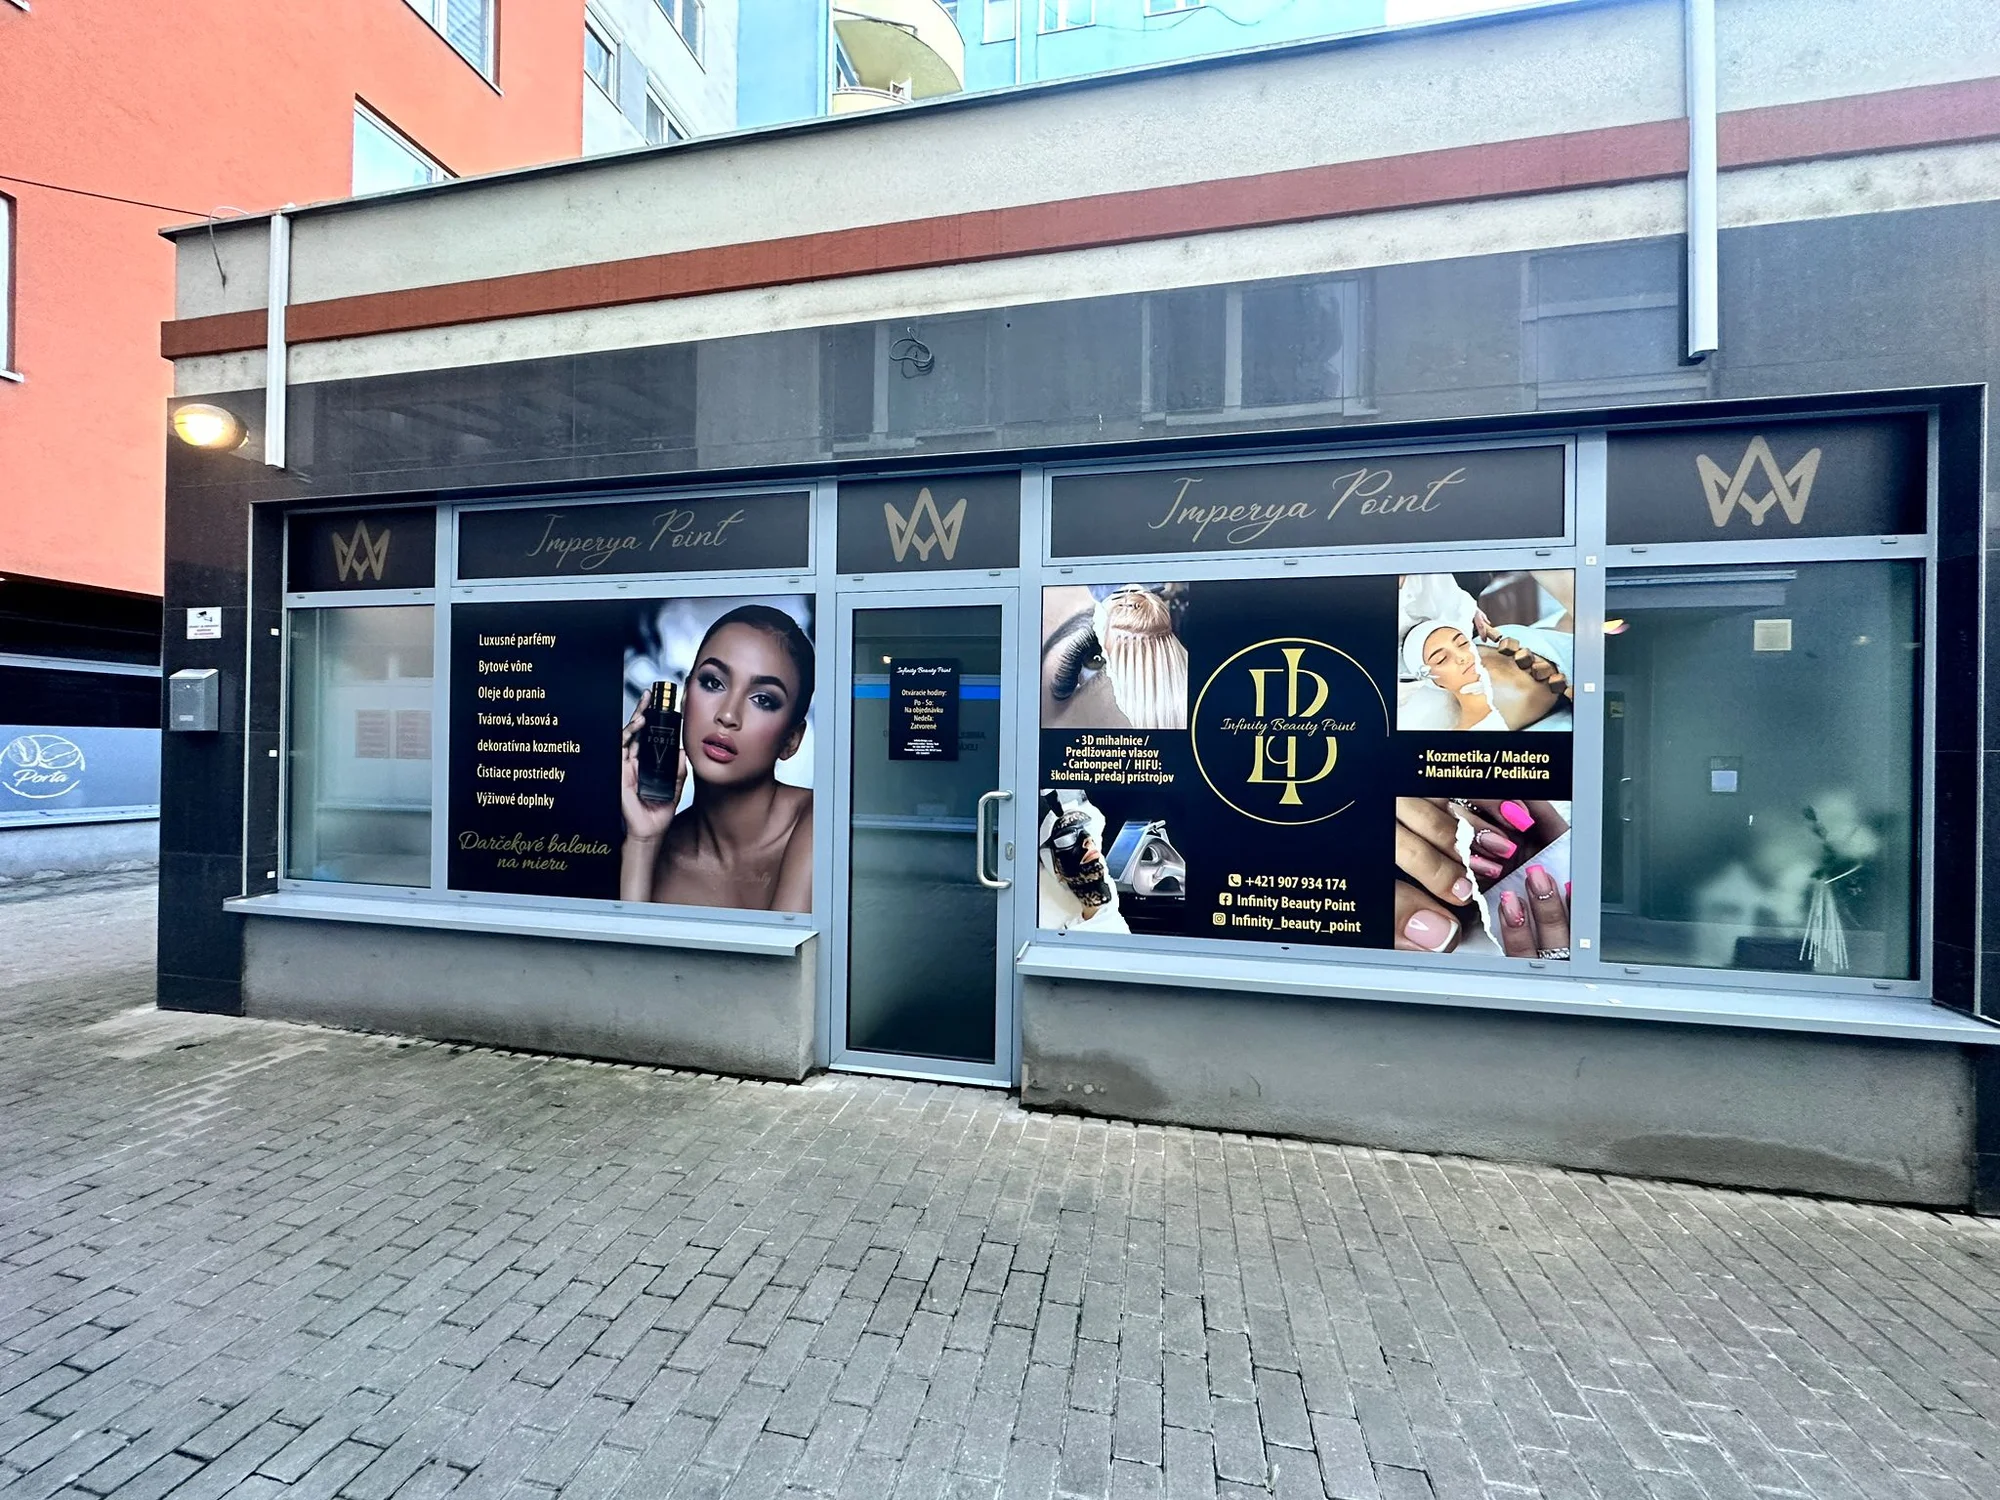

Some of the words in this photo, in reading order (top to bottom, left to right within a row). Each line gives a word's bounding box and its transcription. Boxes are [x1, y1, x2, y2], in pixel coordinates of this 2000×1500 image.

[1148, 477, 1317, 544] Imperya
[1327, 467, 1467, 521] Point
[526, 512, 642, 570] Imperya
[649, 508, 744, 551] Point
[479, 633, 516, 646] Luxusné
[517, 632, 556, 648] parfémy
[478, 660, 509, 675] Bytové
[510, 660, 533, 672] vône
[477, 686, 501, 702] Oleje
[502, 686, 515, 699] do
[516, 687, 546, 702] prania
[477, 712, 515, 727] Tvárová,
[516, 713, 551, 726] vlasová
[552, 716, 559, 726] a
[1220, 717, 1269, 736] Infinity
[1270, 717, 1319, 737] Beauty
[1321, 718, 1357, 732] Point
[477, 739, 531, 752] dekoratívna
[532, 740, 581, 754] kozmetika
[1081, 734, 1094, 746] 3D
[1096, 734, 1143, 746] mihalnice
[1065, 746, 1127, 758] Predlžovanie
[1128, 747, 1160, 759] vlasov
[1426, 749, 1491, 763] Kozmetika
[1502, 750, 1550, 764] Madero
[476, 763, 512, 779] Čistiace
[513, 767, 565, 783] prostriedky
[1068, 759, 1122, 771] Carbonpeel
[1134, 759, 1162, 771] HIFU:
[1425, 765, 1484, 778] Manikúra
[1494, 766, 1550, 780] Pedikúra
[12, 768, 68, 787] Porta
[1050, 770, 1093, 782] školenia,
[1094, 771, 1126, 784] predaj
[476, 791, 516, 807] Výživové
[517, 793, 555, 810] doplnky
[458, 830, 545, 855] Darčekové
[547, 833, 612, 855] balenia
[497, 857, 519, 869] na
[522, 856, 568, 871] mieru
[1245, 875, 1275, 888] +421
[1277, 876, 1299, 889] 907
[1301, 877, 1323, 890] 934
[1325, 878, 1347, 891] 174
[1237, 894, 1279, 911] Infinity
[1281, 896, 1322, 913] Beauty
[1324, 898, 1356, 912] Point
[1231, 913, 1362, 934] Infinity_beauty_point
